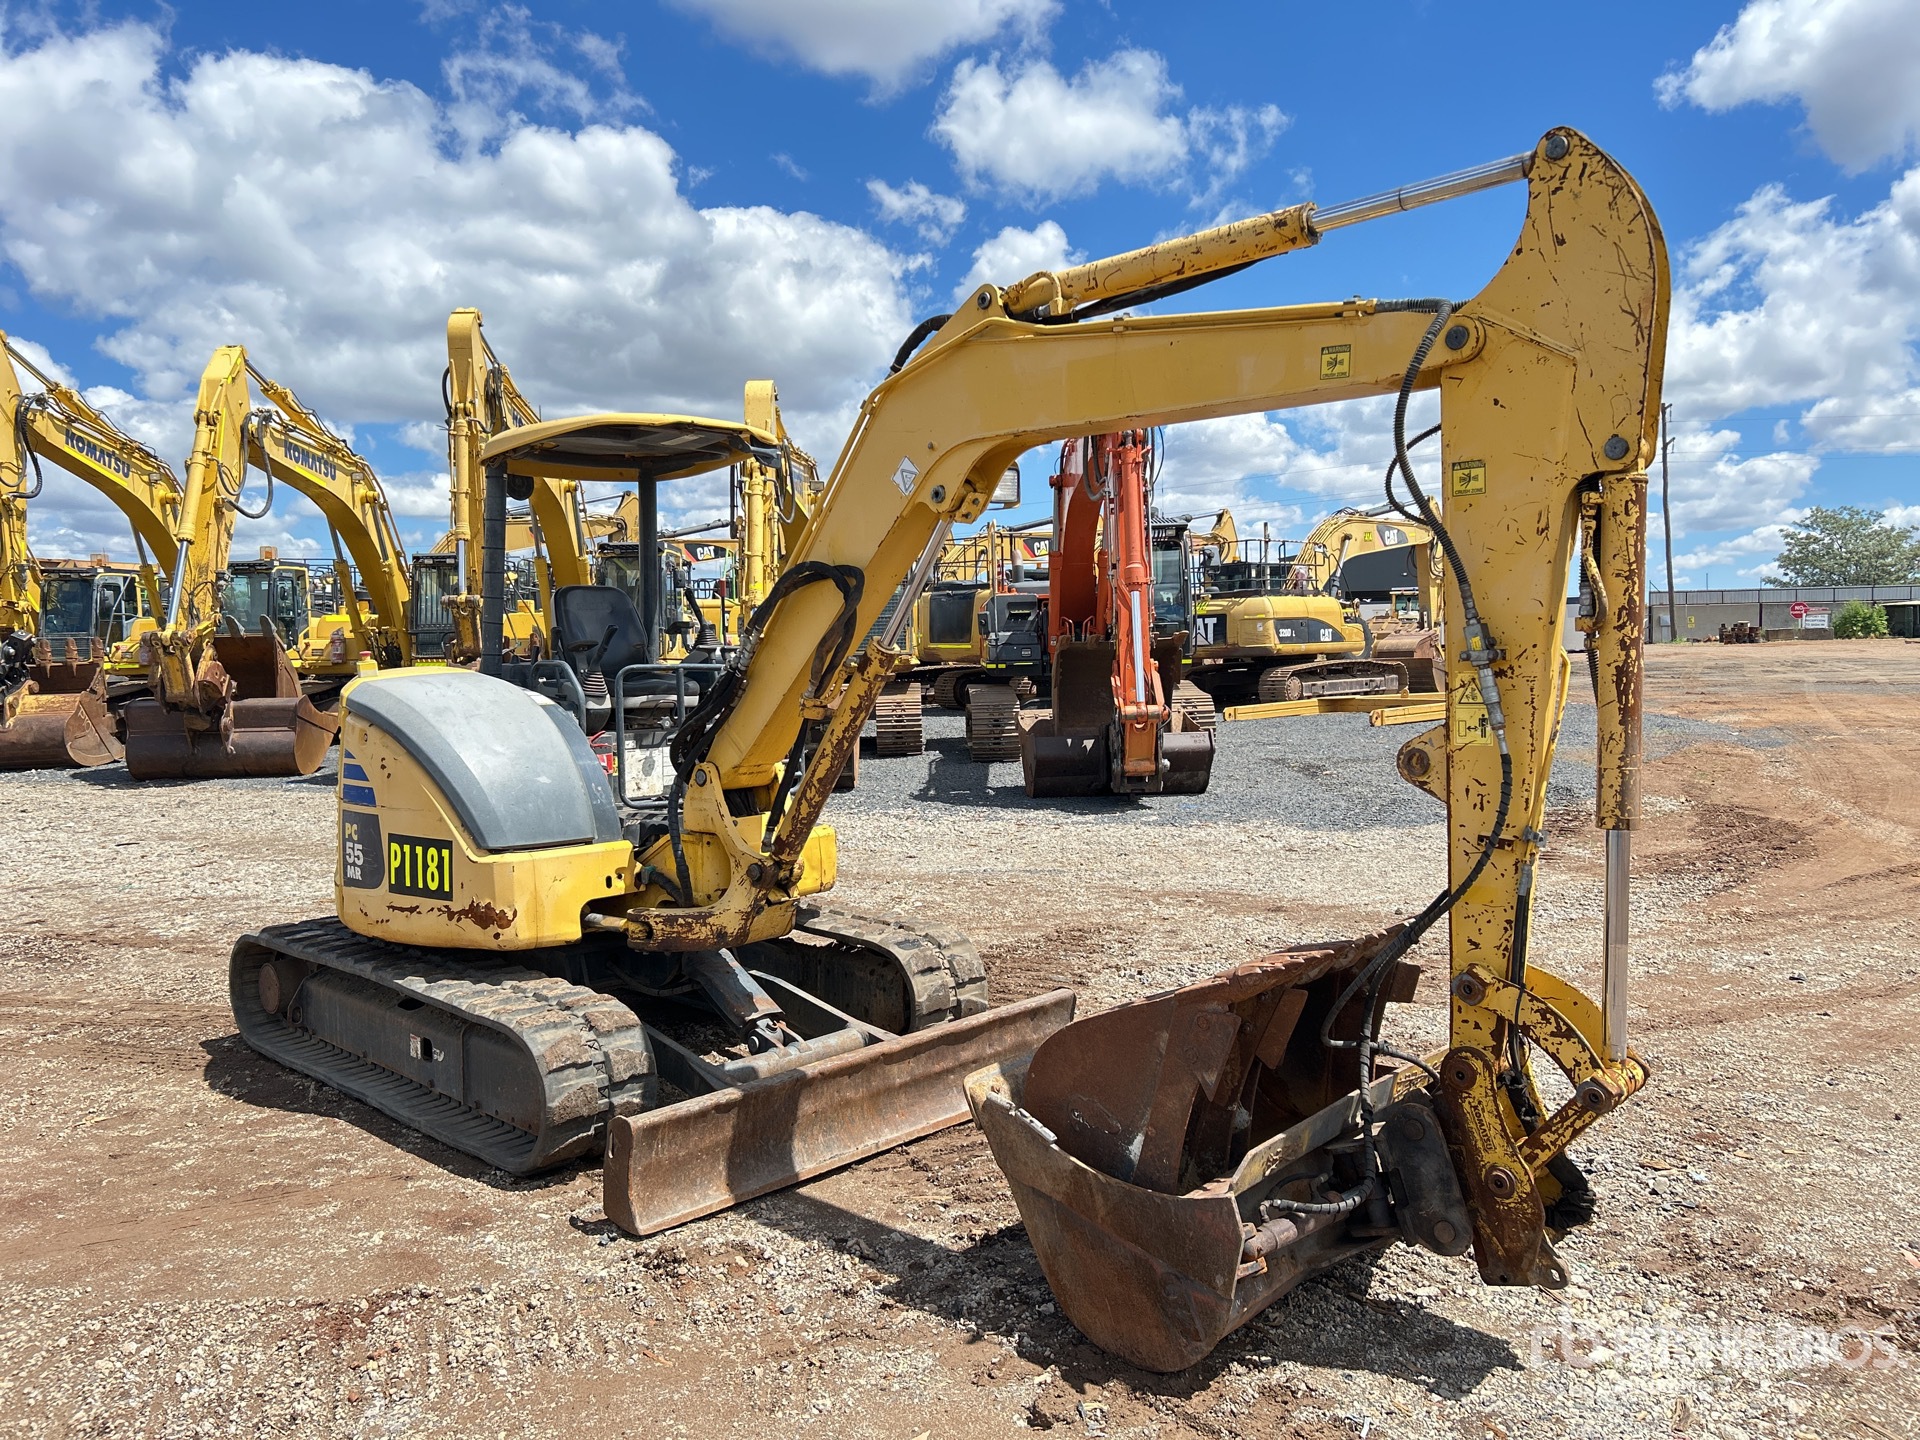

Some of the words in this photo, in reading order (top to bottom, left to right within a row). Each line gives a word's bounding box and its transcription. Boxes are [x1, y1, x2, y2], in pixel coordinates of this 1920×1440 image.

[65, 428, 130, 478] KOMATSU
[284, 439, 337, 481] KOMATSU
[1385, 529, 1398, 546] CAT
[696, 545, 715, 561] CAT
[1193, 617, 1217, 646] AT
[1320, 629, 1333, 642] CAT
[345, 822, 358, 841] PC
[345, 841, 364, 866] 55
[347, 864, 363, 881] MR
[390, 842, 450, 892] P1181
[1472, 1104, 1493, 1150] KOMATSU
